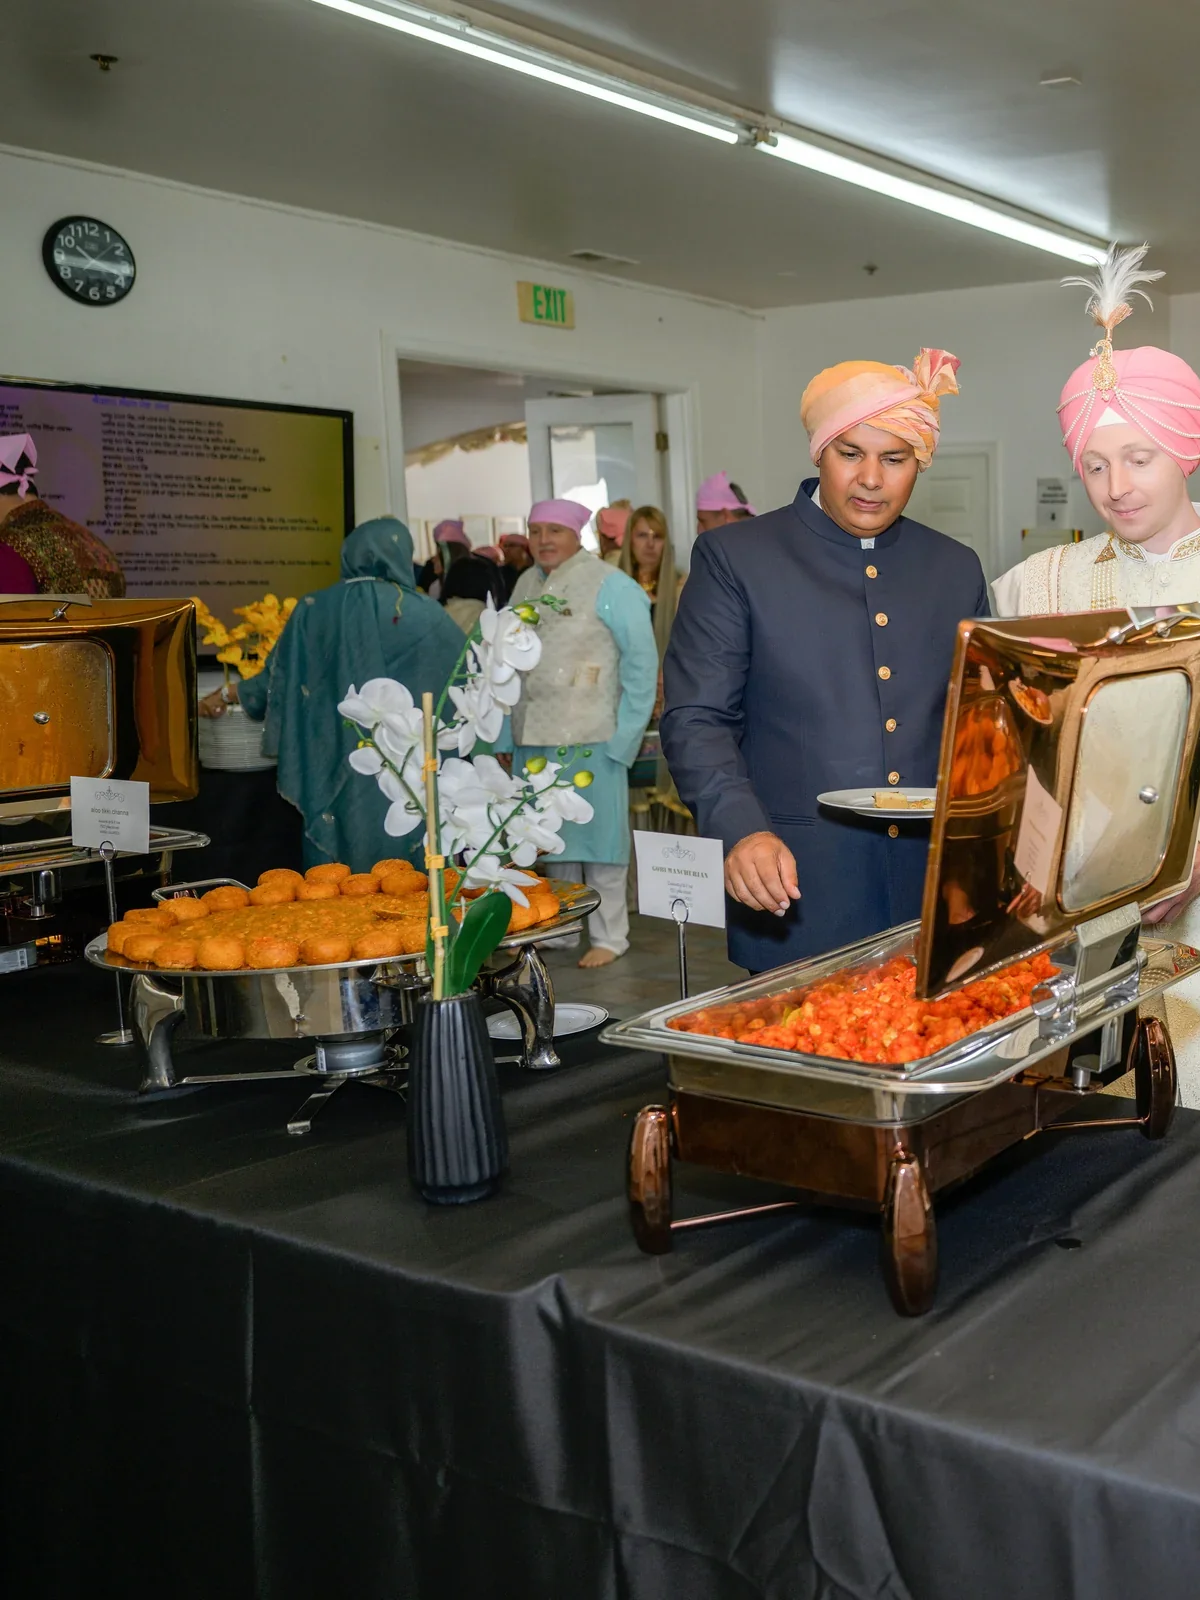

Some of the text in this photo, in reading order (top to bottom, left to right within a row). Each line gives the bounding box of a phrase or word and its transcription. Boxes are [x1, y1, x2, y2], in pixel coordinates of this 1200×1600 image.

[69, 224, 82, 238] 11
[83, 222, 99, 237] 12
[58, 234, 75, 248] 10
[104, 231, 110, 243] 1
[114, 243, 125, 256] 2
[60, 266, 71, 279] 8
[75, 280, 84, 292] 7
[106, 285, 116, 298] 5
[89, 287, 100, 300] 6
[533, 284, 567, 324] EXIT
[668, 867, 709, 878] MANCHURIAN
